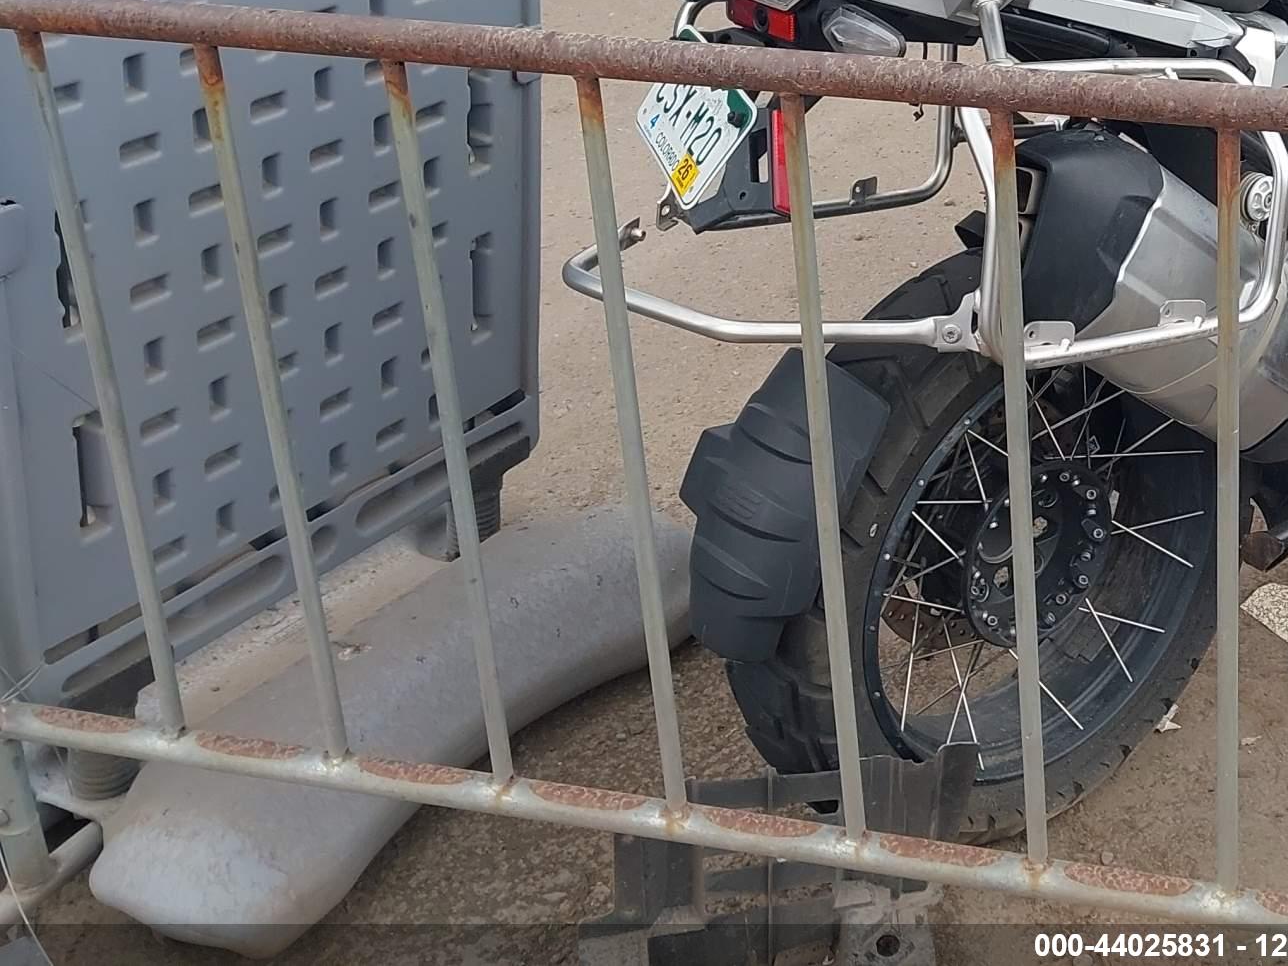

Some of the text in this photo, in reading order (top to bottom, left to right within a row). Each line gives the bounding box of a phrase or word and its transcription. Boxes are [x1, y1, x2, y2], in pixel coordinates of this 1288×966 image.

[649, 114, 660, 129] 4
[655, 132, 680, 171] COLORADO
[677, 158, 693, 181] 26
